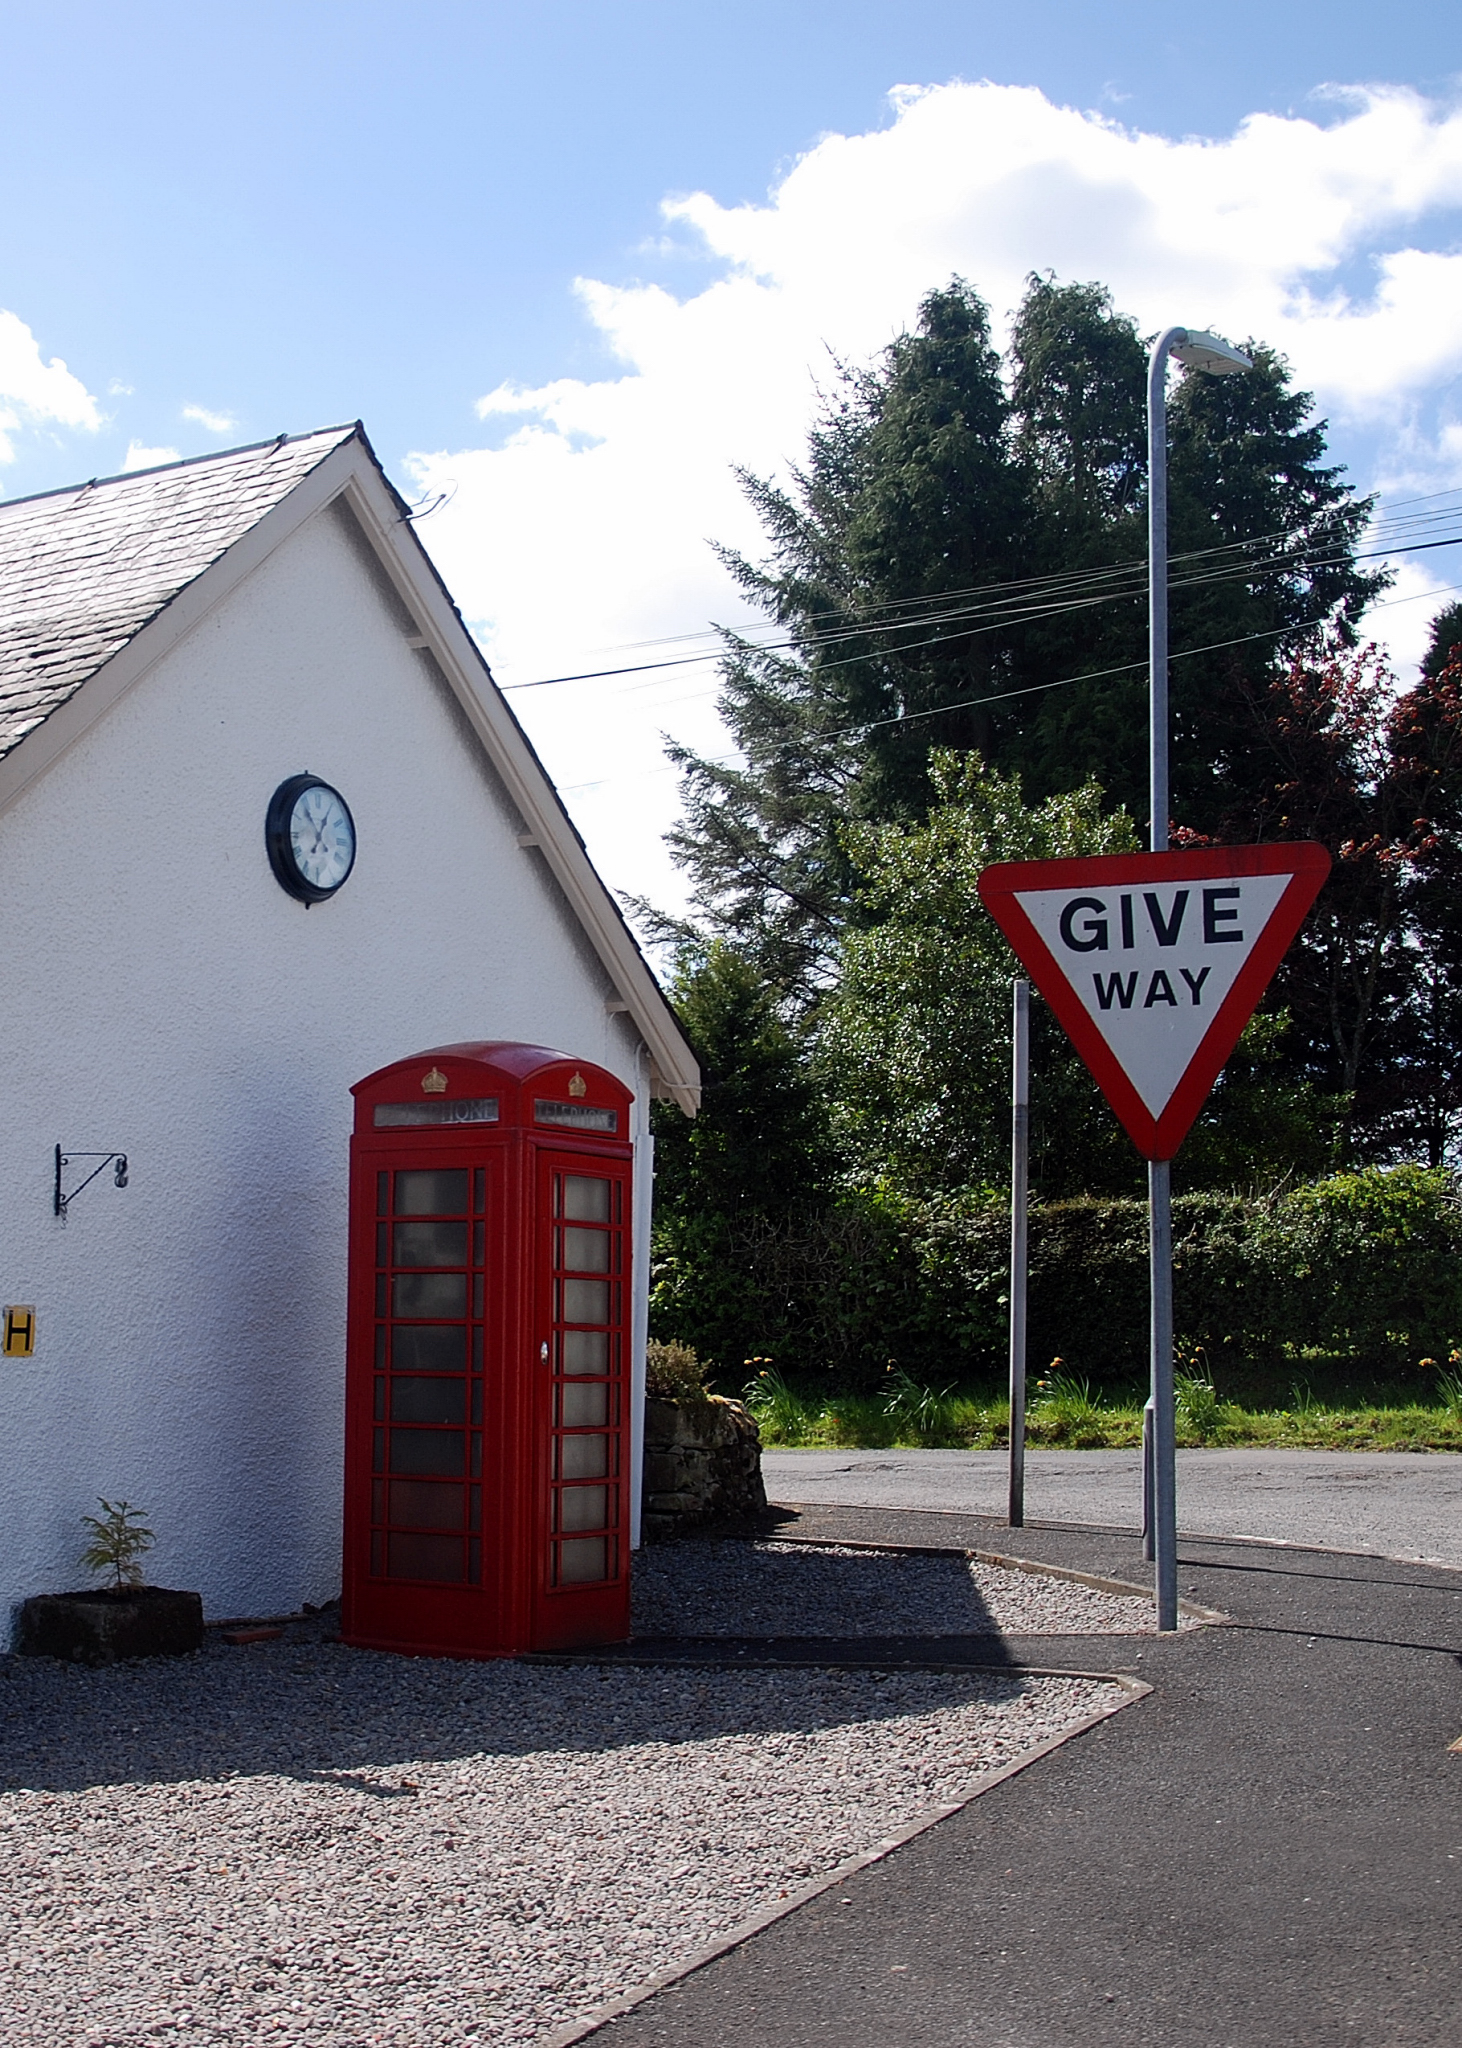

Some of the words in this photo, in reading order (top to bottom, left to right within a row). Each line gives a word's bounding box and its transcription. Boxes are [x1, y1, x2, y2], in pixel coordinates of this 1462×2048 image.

[1059, 887, 1243, 952] GIVE
[1093, 967, 1211, 1010] WAY
[7, 1310, 31, 1351] H
